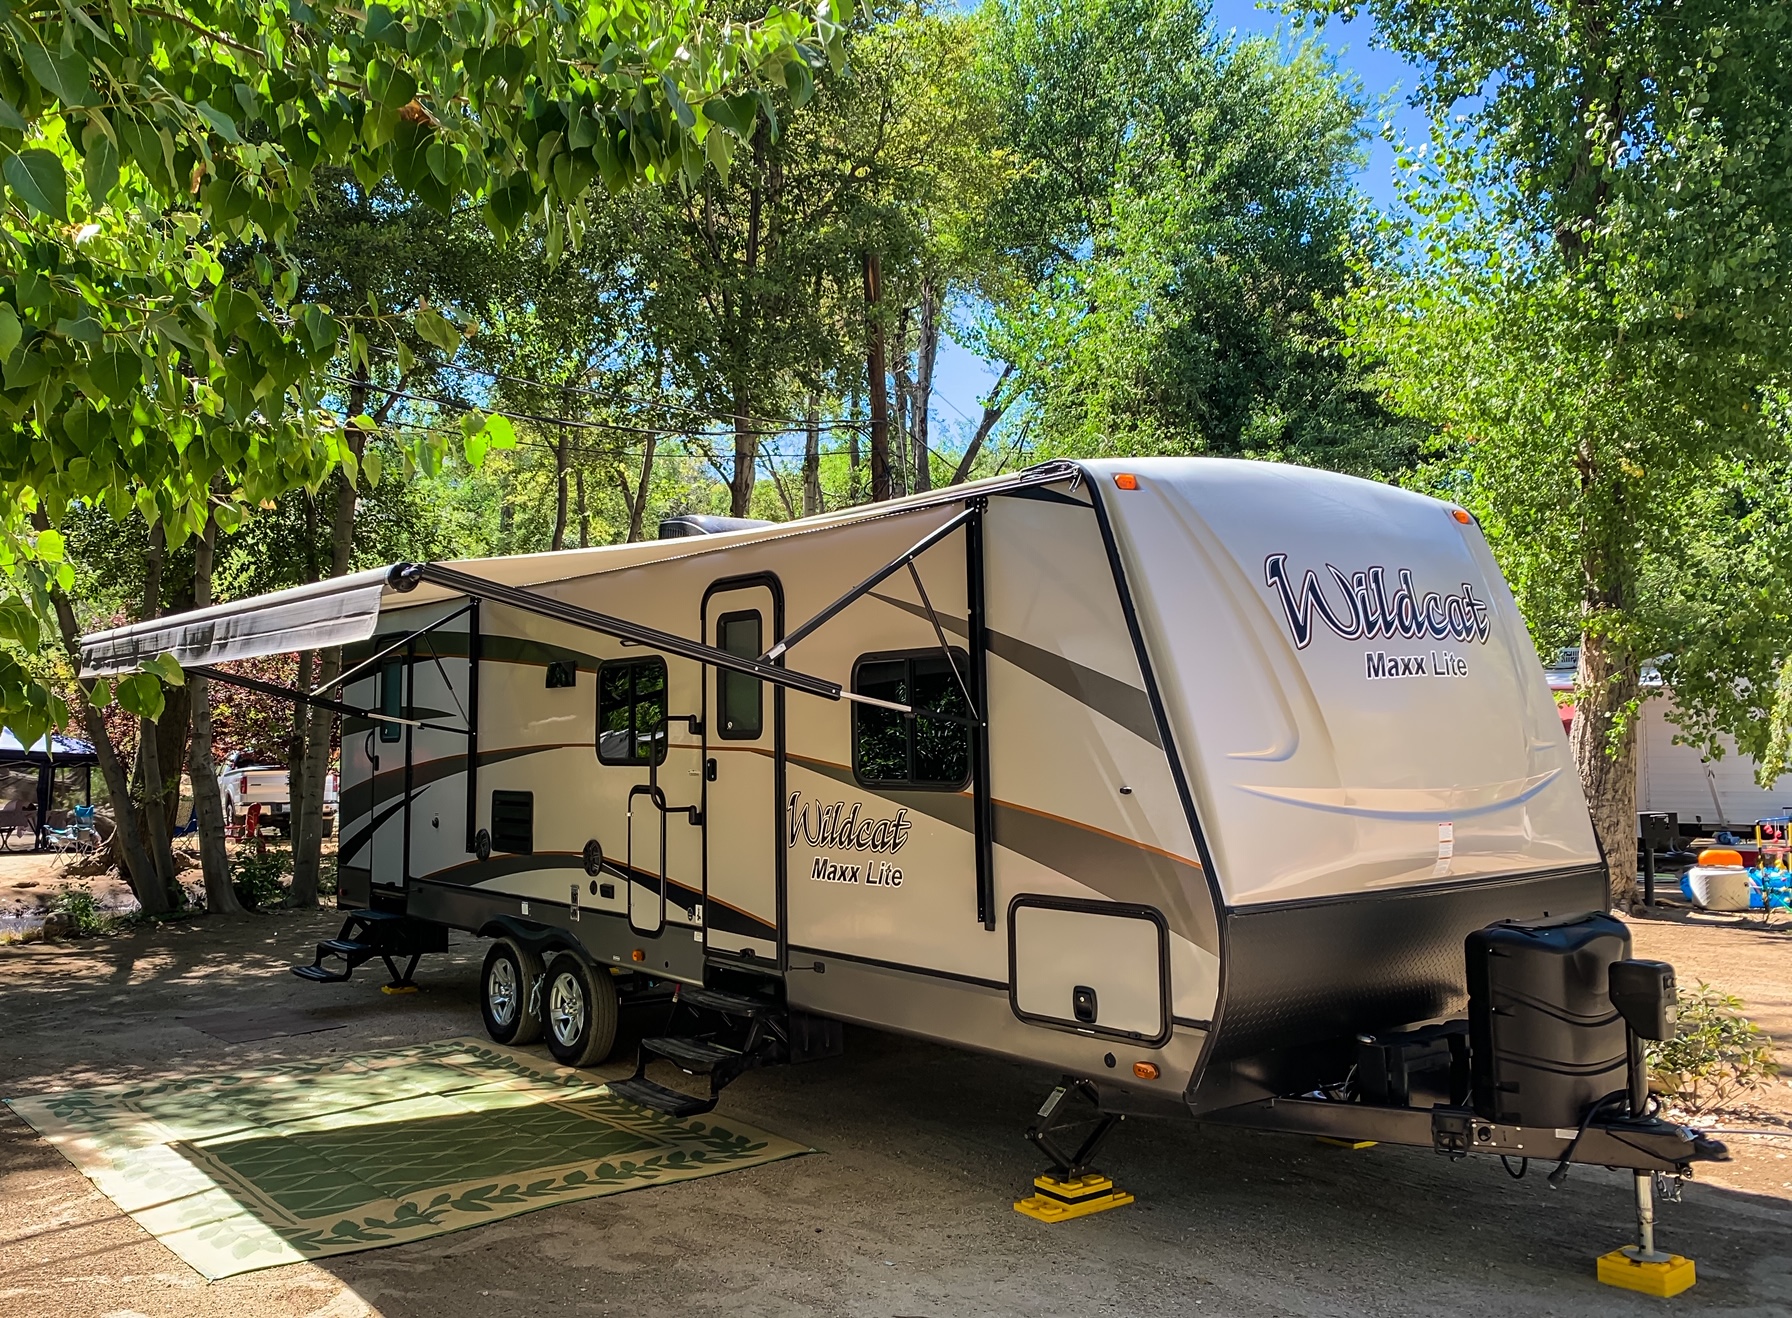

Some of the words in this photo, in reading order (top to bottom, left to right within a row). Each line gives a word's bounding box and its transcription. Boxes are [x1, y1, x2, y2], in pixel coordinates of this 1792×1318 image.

[1265, 553, 1490, 649] Wildcat
[1366, 652, 1427, 679] Maxx
[1432, 651, 1468, 677] Lite
[787, 791, 912, 853] Wildcat
[811, 857, 861, 883] Maxx
[865, 861, 903, 887] Lite
